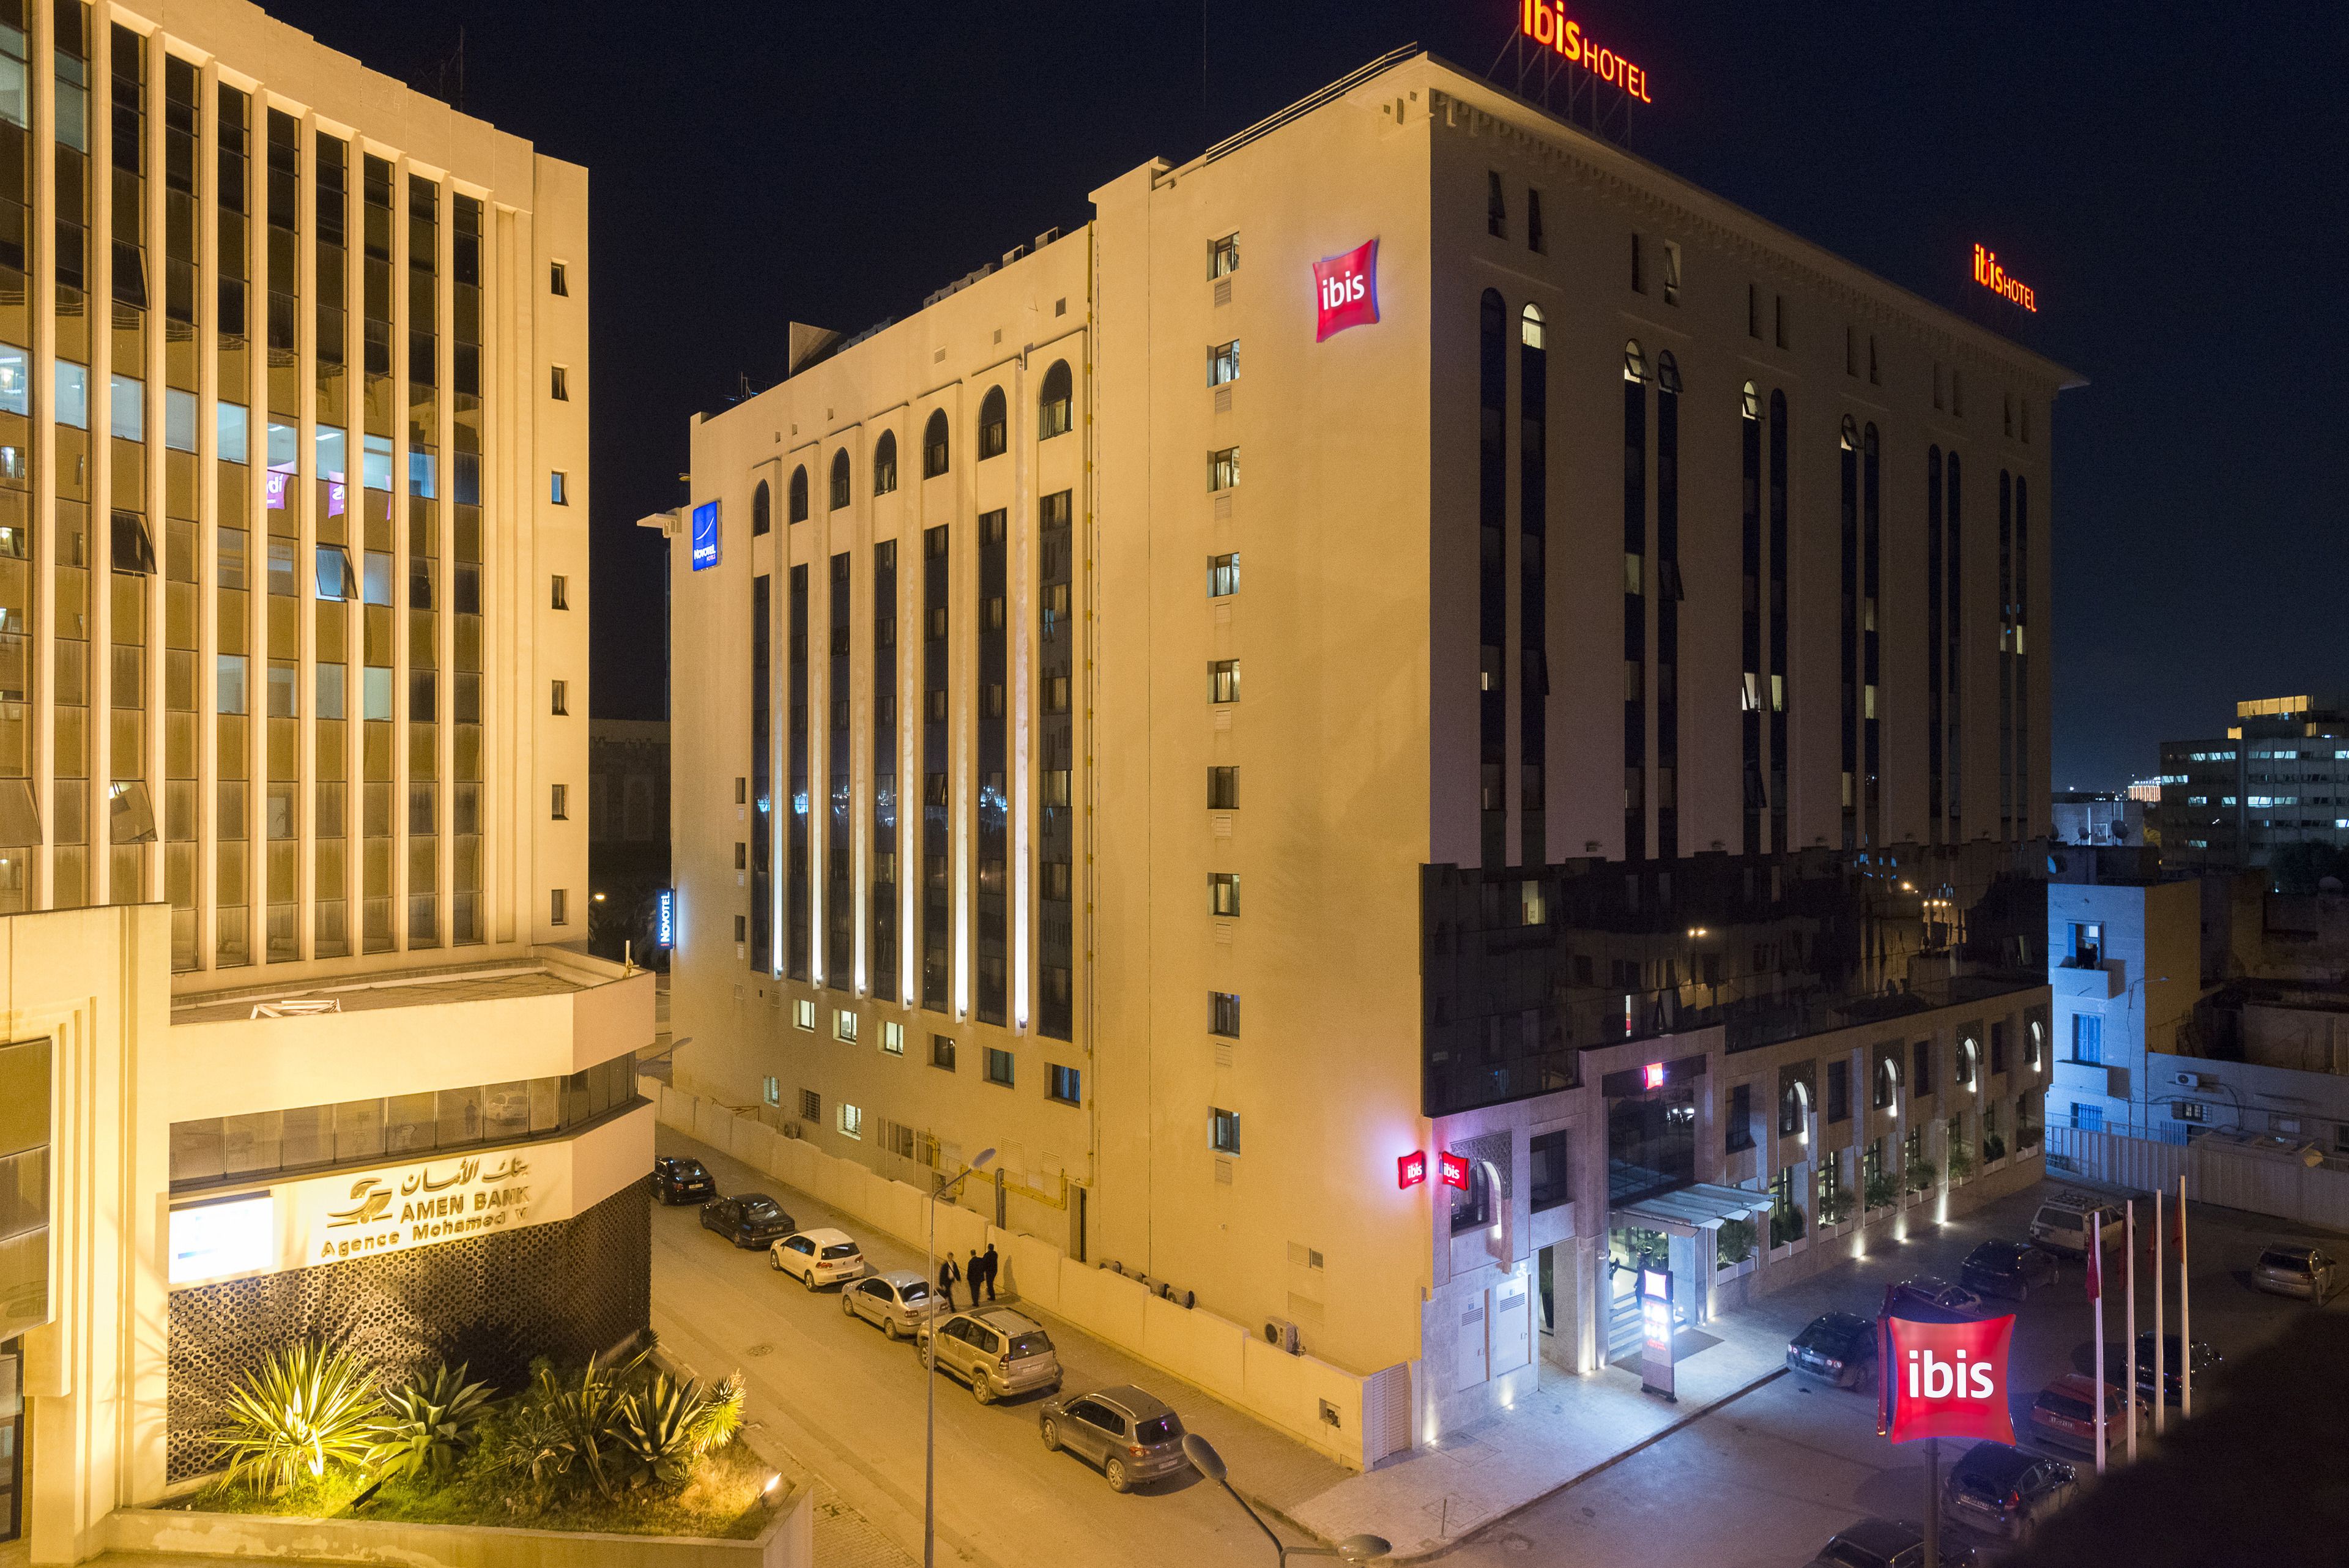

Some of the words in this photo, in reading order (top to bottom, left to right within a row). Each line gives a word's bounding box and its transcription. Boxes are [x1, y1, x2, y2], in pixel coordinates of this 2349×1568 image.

[1584, 37, 1651, 103] HOTEL
[1322, 270, 1365, 310] ibis
[1975, 243, 2003, 294] ibis
[2003, 275, 2037, 313] HOTEL
[661, 891, 670, 942] NOVOTEL
[1408, 1162, 1422, 1179] ibis
[1444, 1162, 1460, 1180] ibis
[399, 1195, 464, 1224] AMEN
[474, 1186, 530, 1212] BANK
[321, 1231, 400, 1258] Agence
[412, 1211, 506, 1241] Mohamed
[1909, 1349, 1994, 1399] ibis
